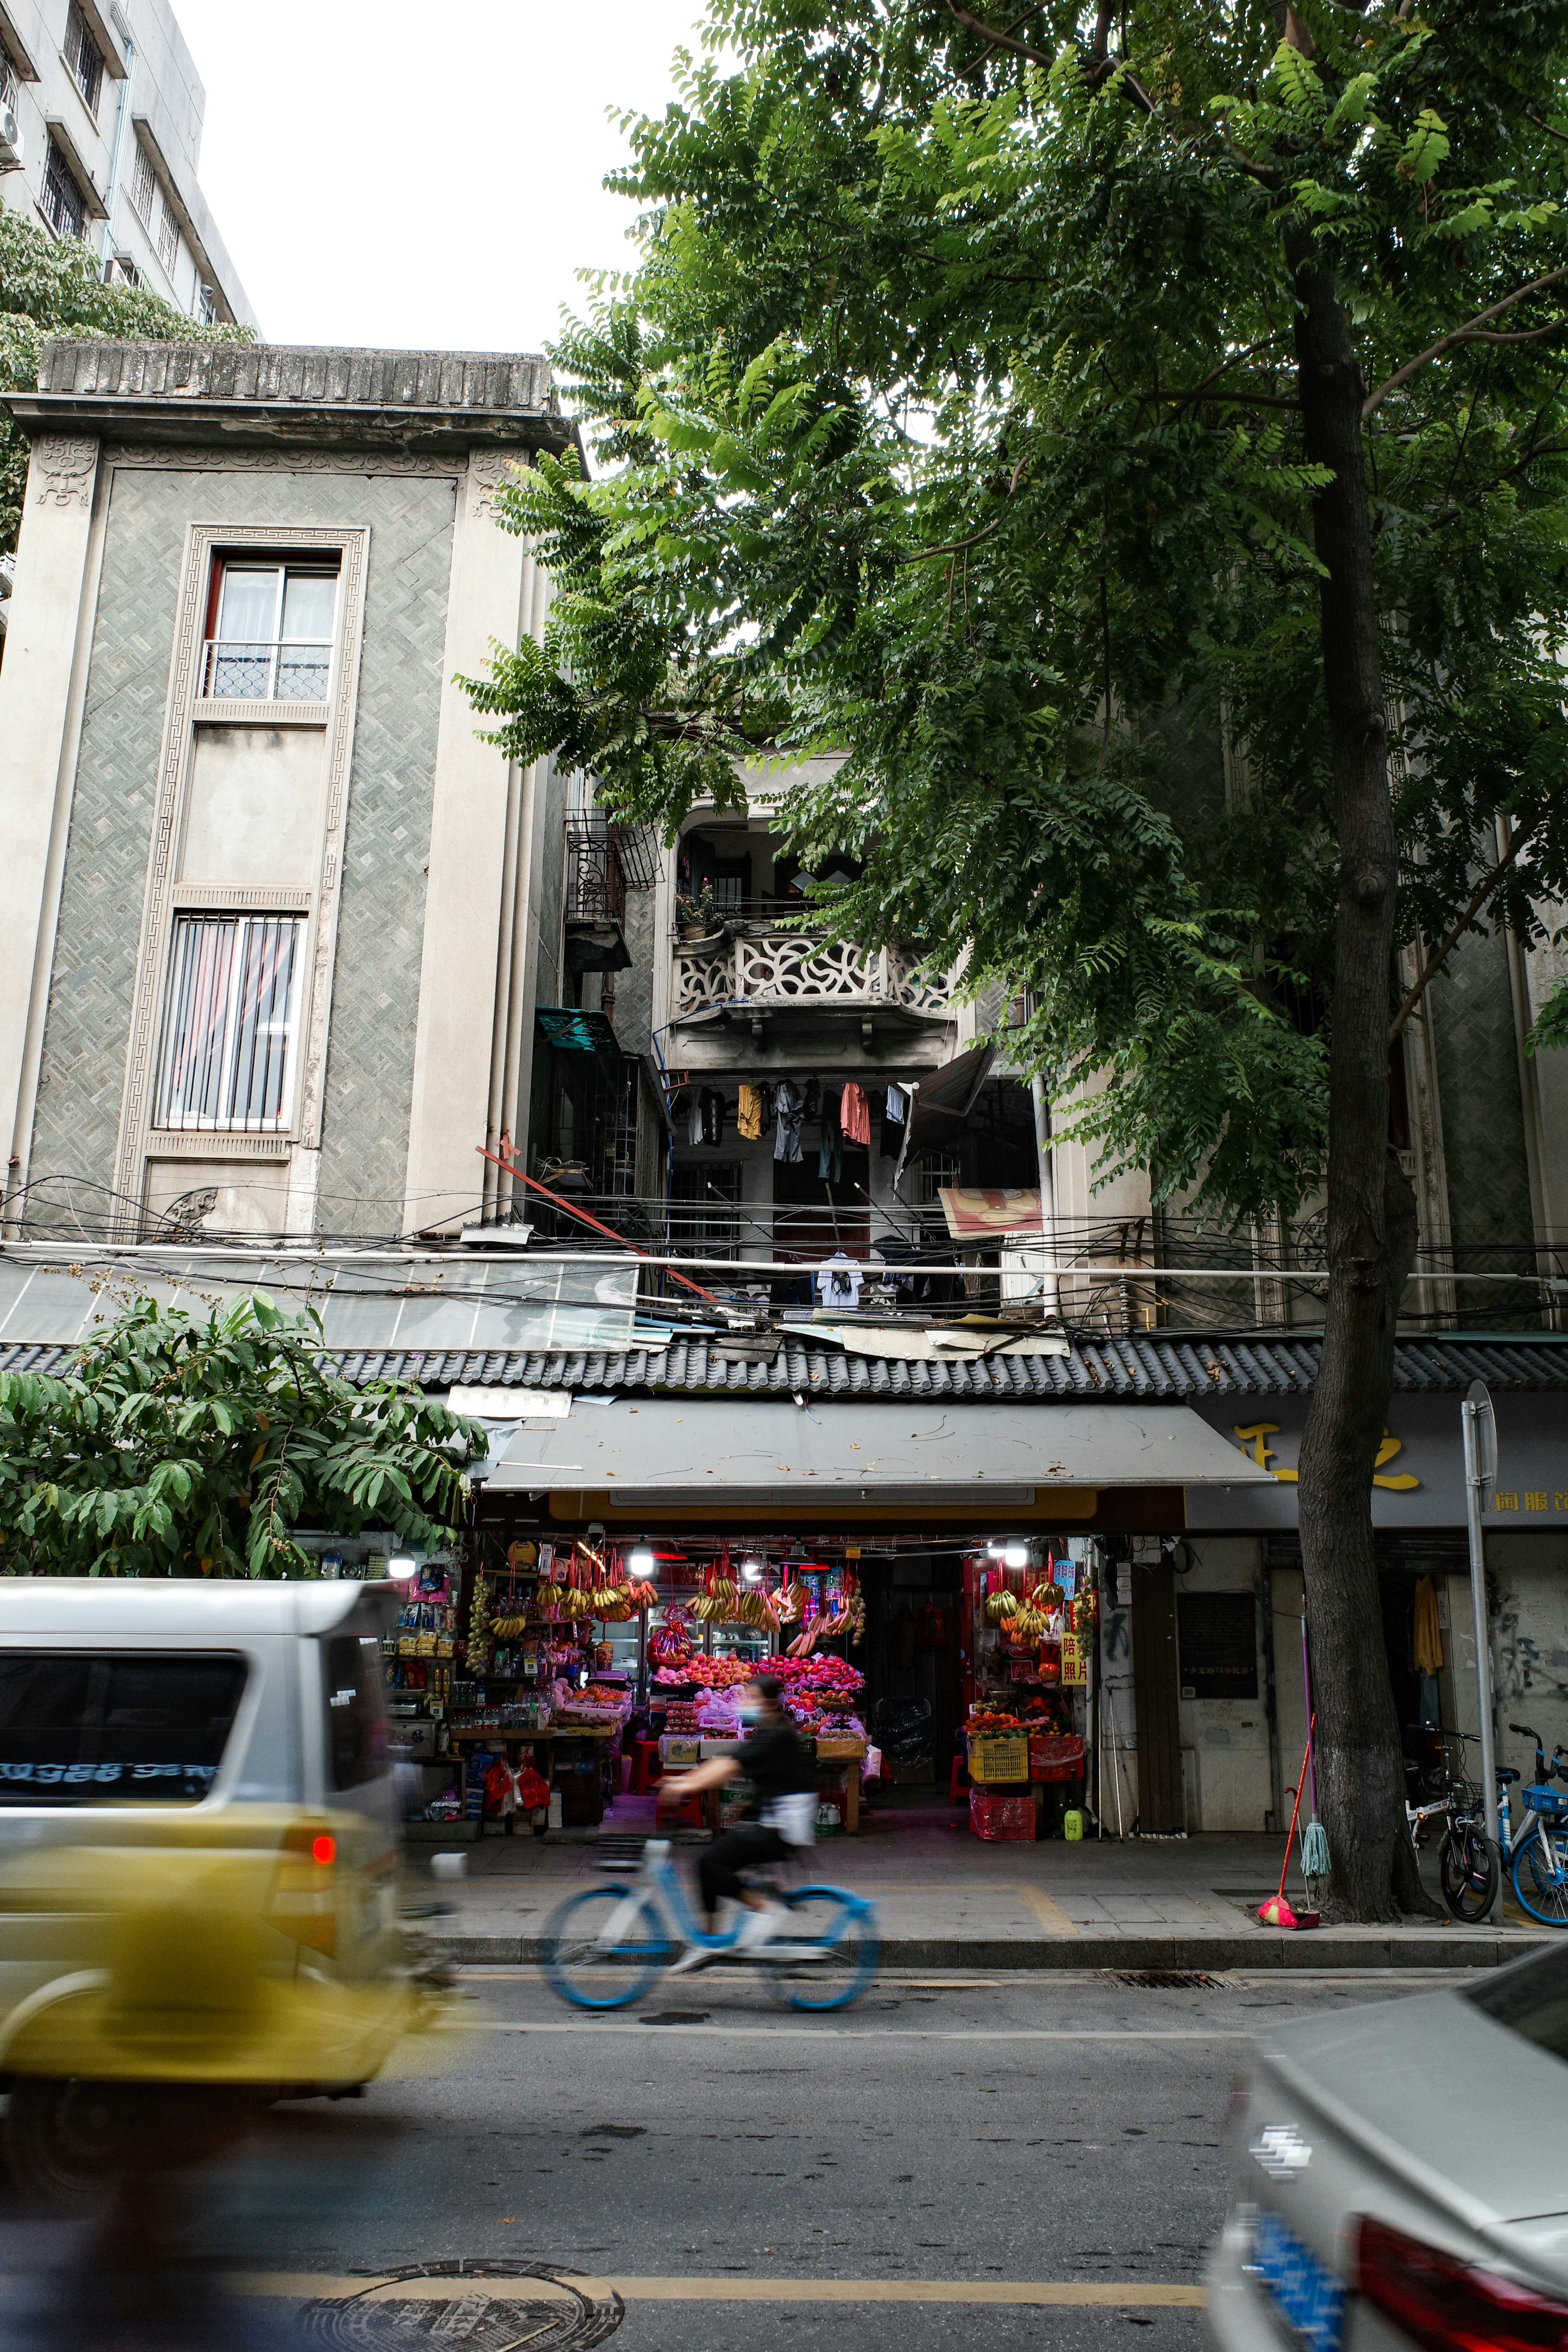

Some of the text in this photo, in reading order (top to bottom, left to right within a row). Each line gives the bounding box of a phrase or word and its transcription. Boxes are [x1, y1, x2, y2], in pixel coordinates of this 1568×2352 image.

[1486, 1491, 1568, 1512] 闲服饰
[1064, 1661, 1087, 1680] 照片
